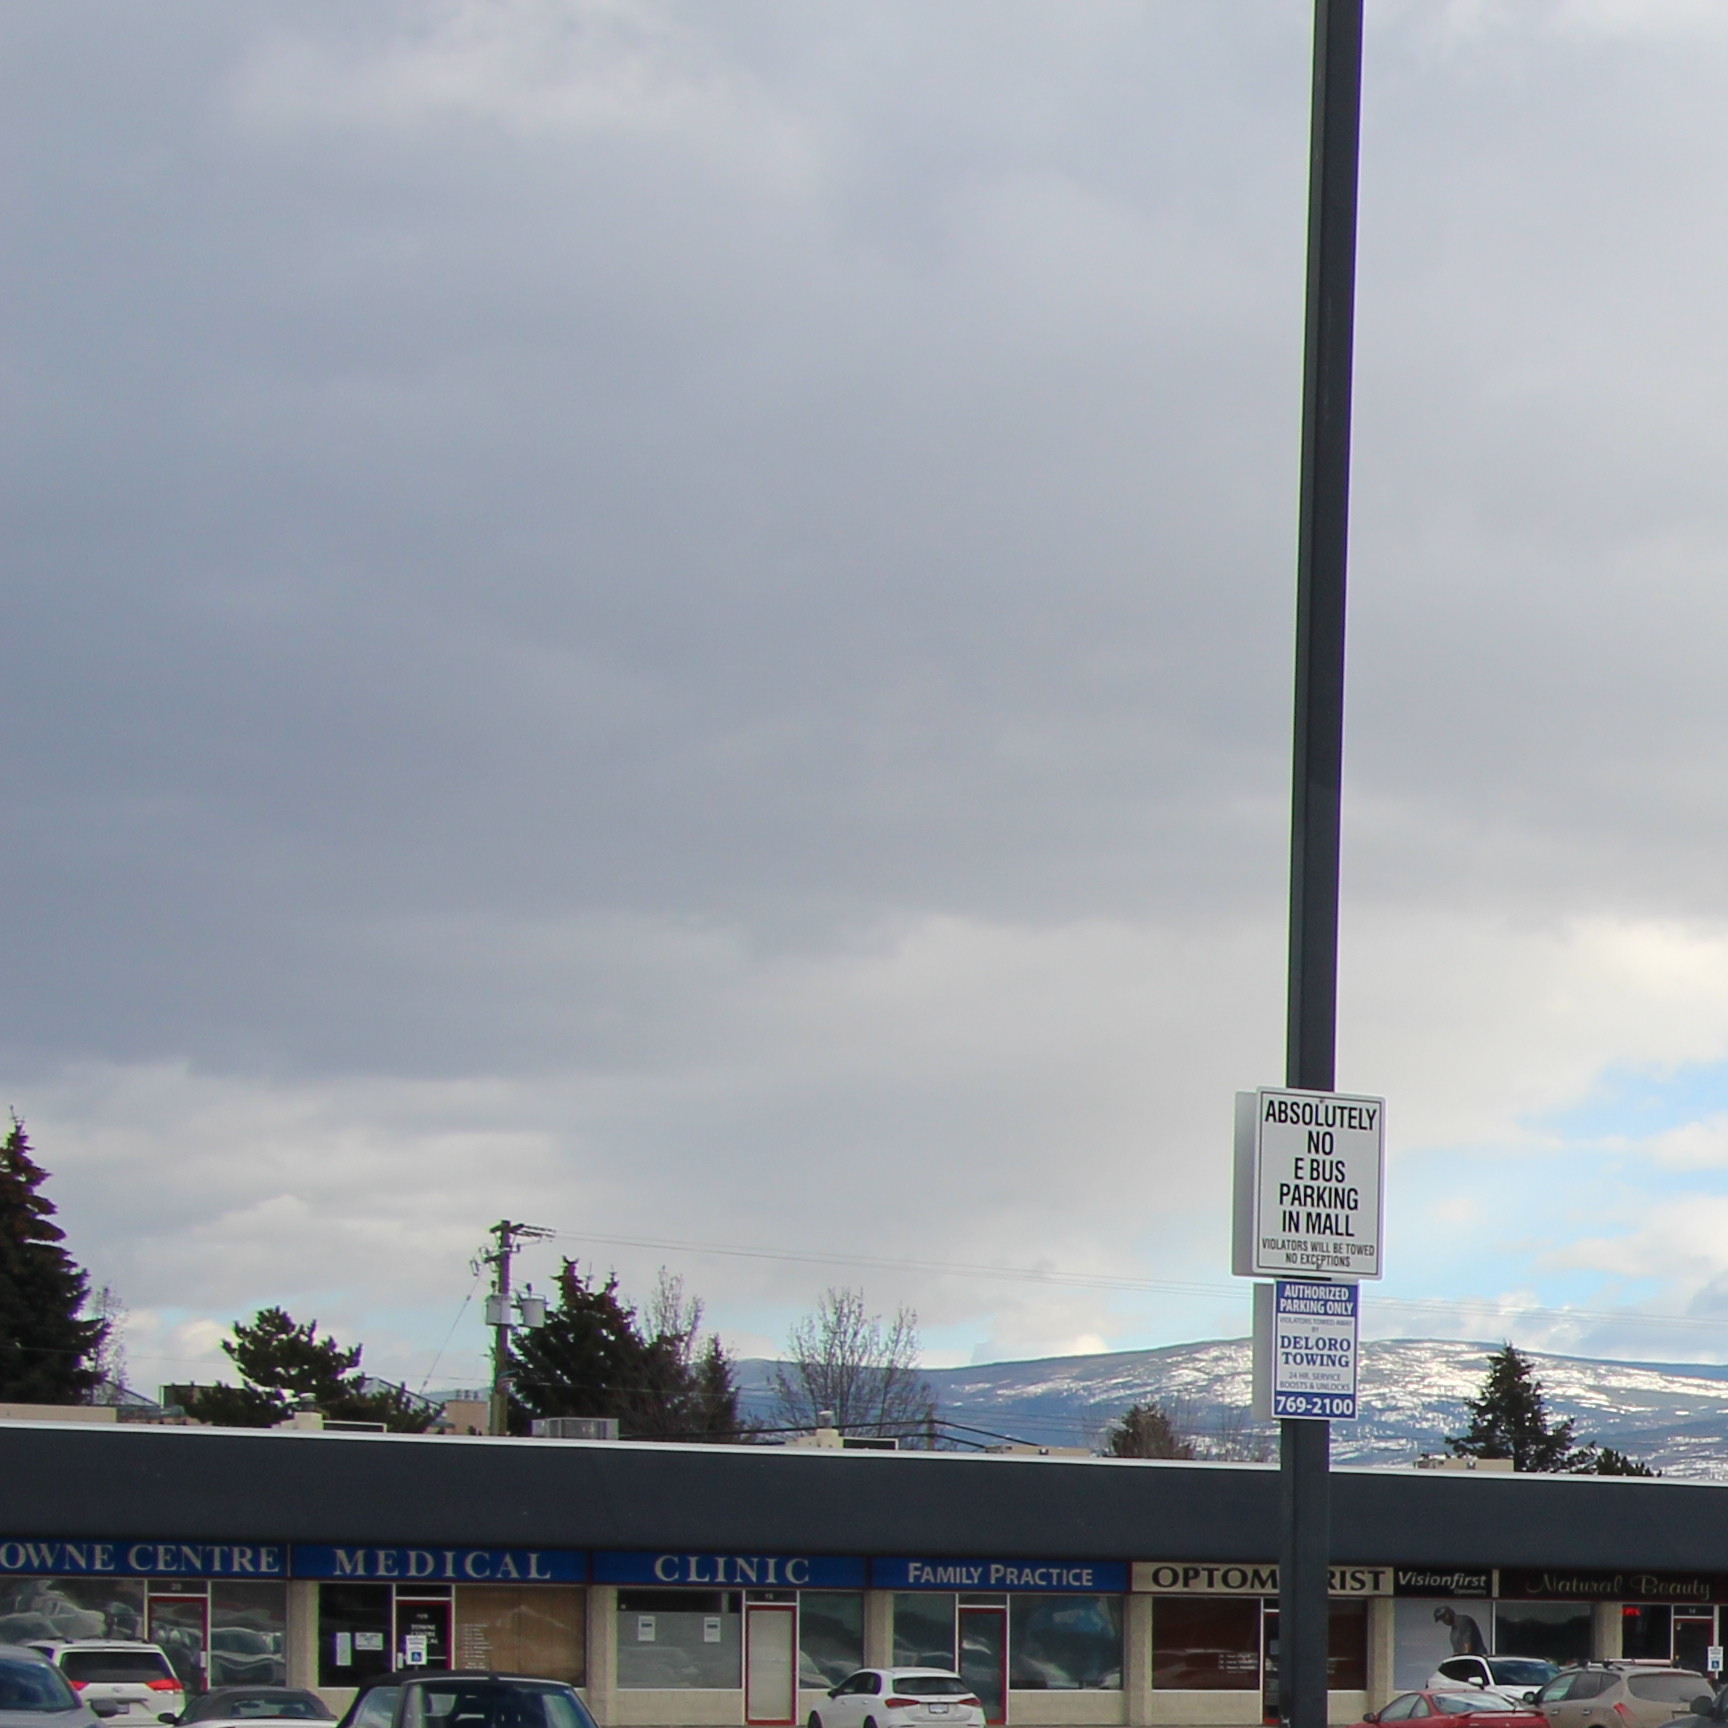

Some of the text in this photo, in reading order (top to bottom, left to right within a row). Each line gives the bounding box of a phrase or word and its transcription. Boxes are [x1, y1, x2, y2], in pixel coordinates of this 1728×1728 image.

[1265, 1100, 1377, 1130] ABSOLUTELY
[1307, 1130, 1334, 1155] NO
[1294, 1157, 1346, 1183] E BUS
[1279, 1183, 1359, 1211] PARKING
[1282, 1210, 1355, 1237] IN MALL
[1262, 1238, 1376, 1257] VIOLATORS WILL BE TOWED
[1285, 1252, 1351, 1268] NO EXCEPTIONS
[1284, 1284, 1349, 1301] AUTHORIZED
[1280, 1298, 1354, 1316] PARKING ONLY
[1280, 1335, 1351, 1352] DELORO
[1281, 1351, 1350, 1368] TOWING
[1276, 1396, 1354, 1416] 769-2100
[128, 1544, 280, 1573] CENTRE
[333, 1549, 551, 1580] MEDICAL
[654, 1554, 809, 1584] CLINIC
[1398, 1571, 1488, 1588] Visionfirst
[1525, 1573, 1623, 1594] Natural
[1629, 1575, 1711, 1601] Beauty
